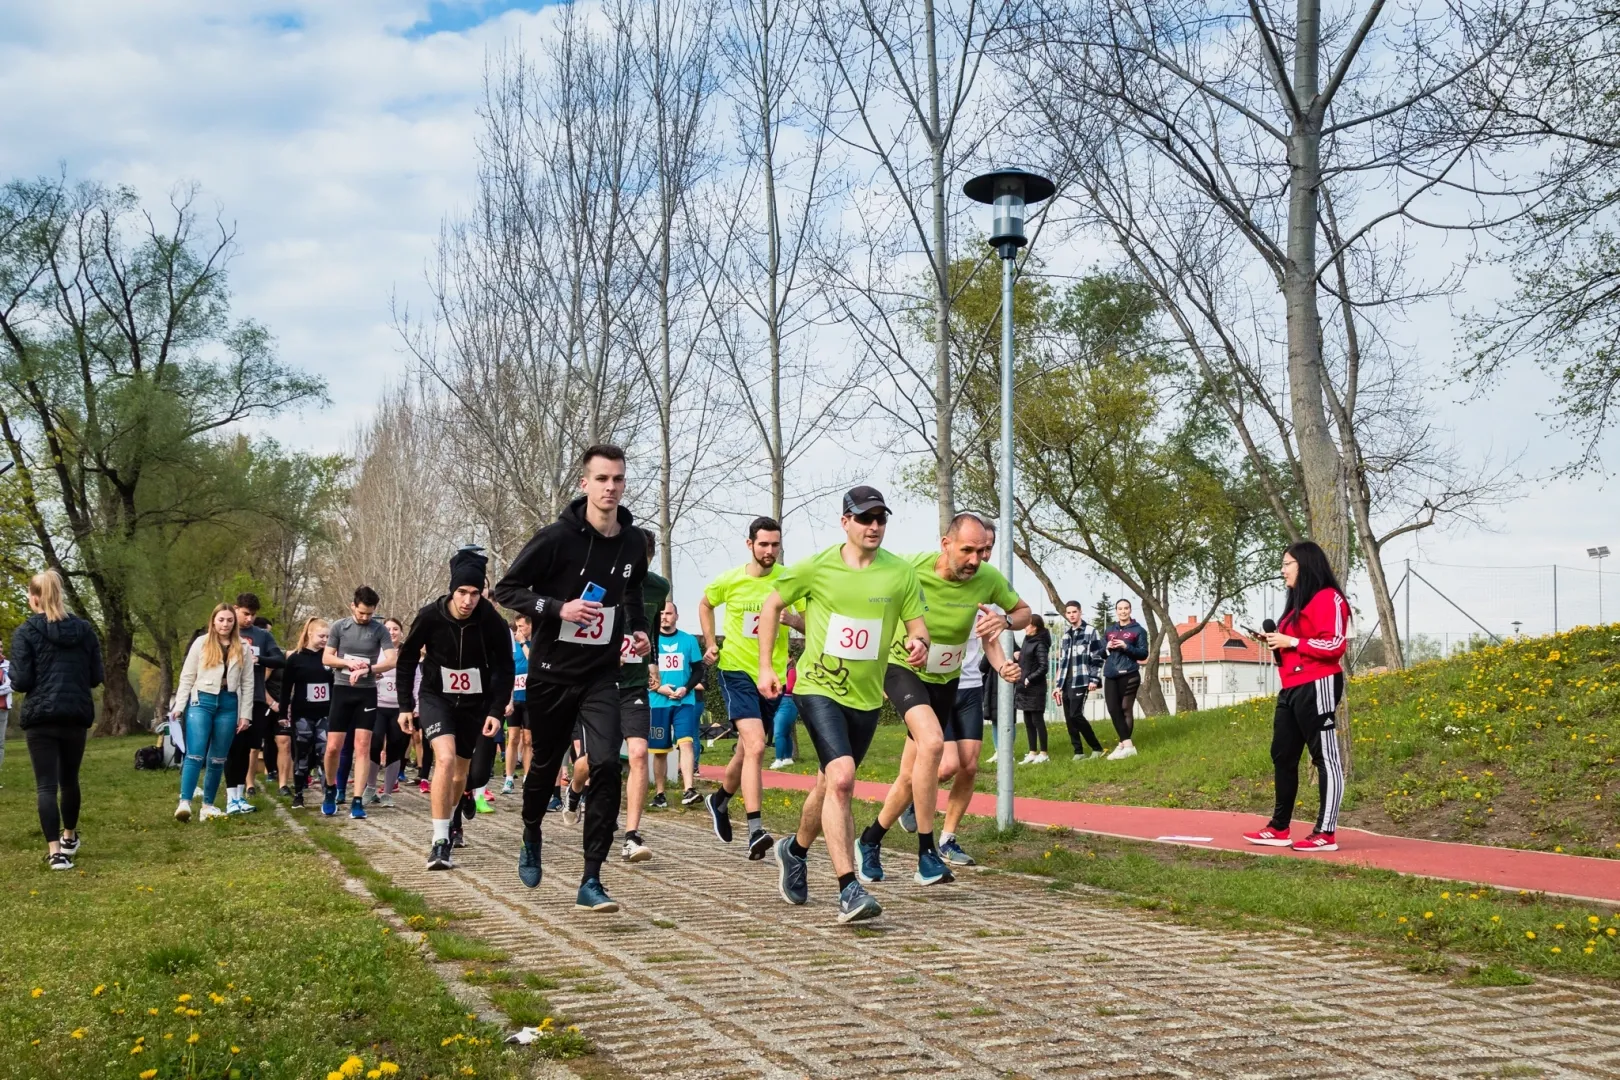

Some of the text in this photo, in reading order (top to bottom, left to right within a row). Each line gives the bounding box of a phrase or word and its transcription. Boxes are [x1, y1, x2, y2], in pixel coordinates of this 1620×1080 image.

[840, 627, 869, 650] 30
[665, 655, 679, 669] 36
[939, 648, 962, 667] 21
[449, 672, 471, 690] 28
[514, 676, 526, 688] 43
[313, 685, 326, 699] 39
